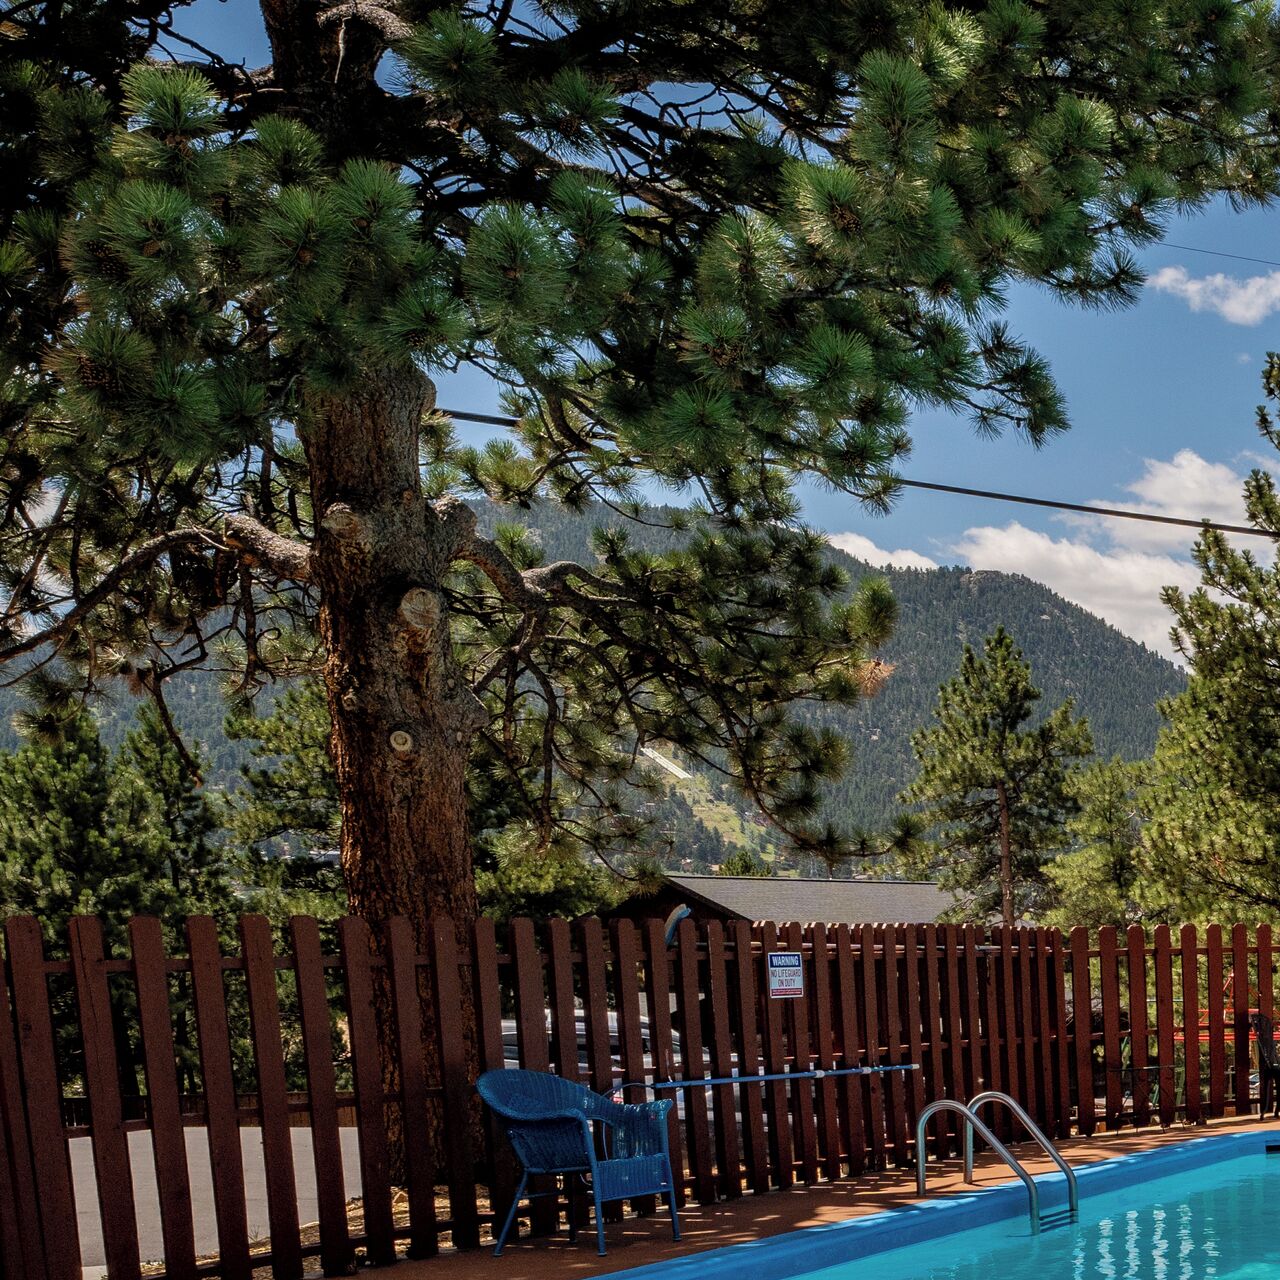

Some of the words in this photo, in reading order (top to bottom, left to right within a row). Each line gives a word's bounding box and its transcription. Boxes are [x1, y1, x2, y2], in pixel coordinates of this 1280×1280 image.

[772, 956, 799, 966] WARNING
[771, 969, 777, 978] NO
[778, 968, 801, 978] LIFEGUARD
[778, 978, 784, 987] ON
[785, 978, 796, 987] DUTY
